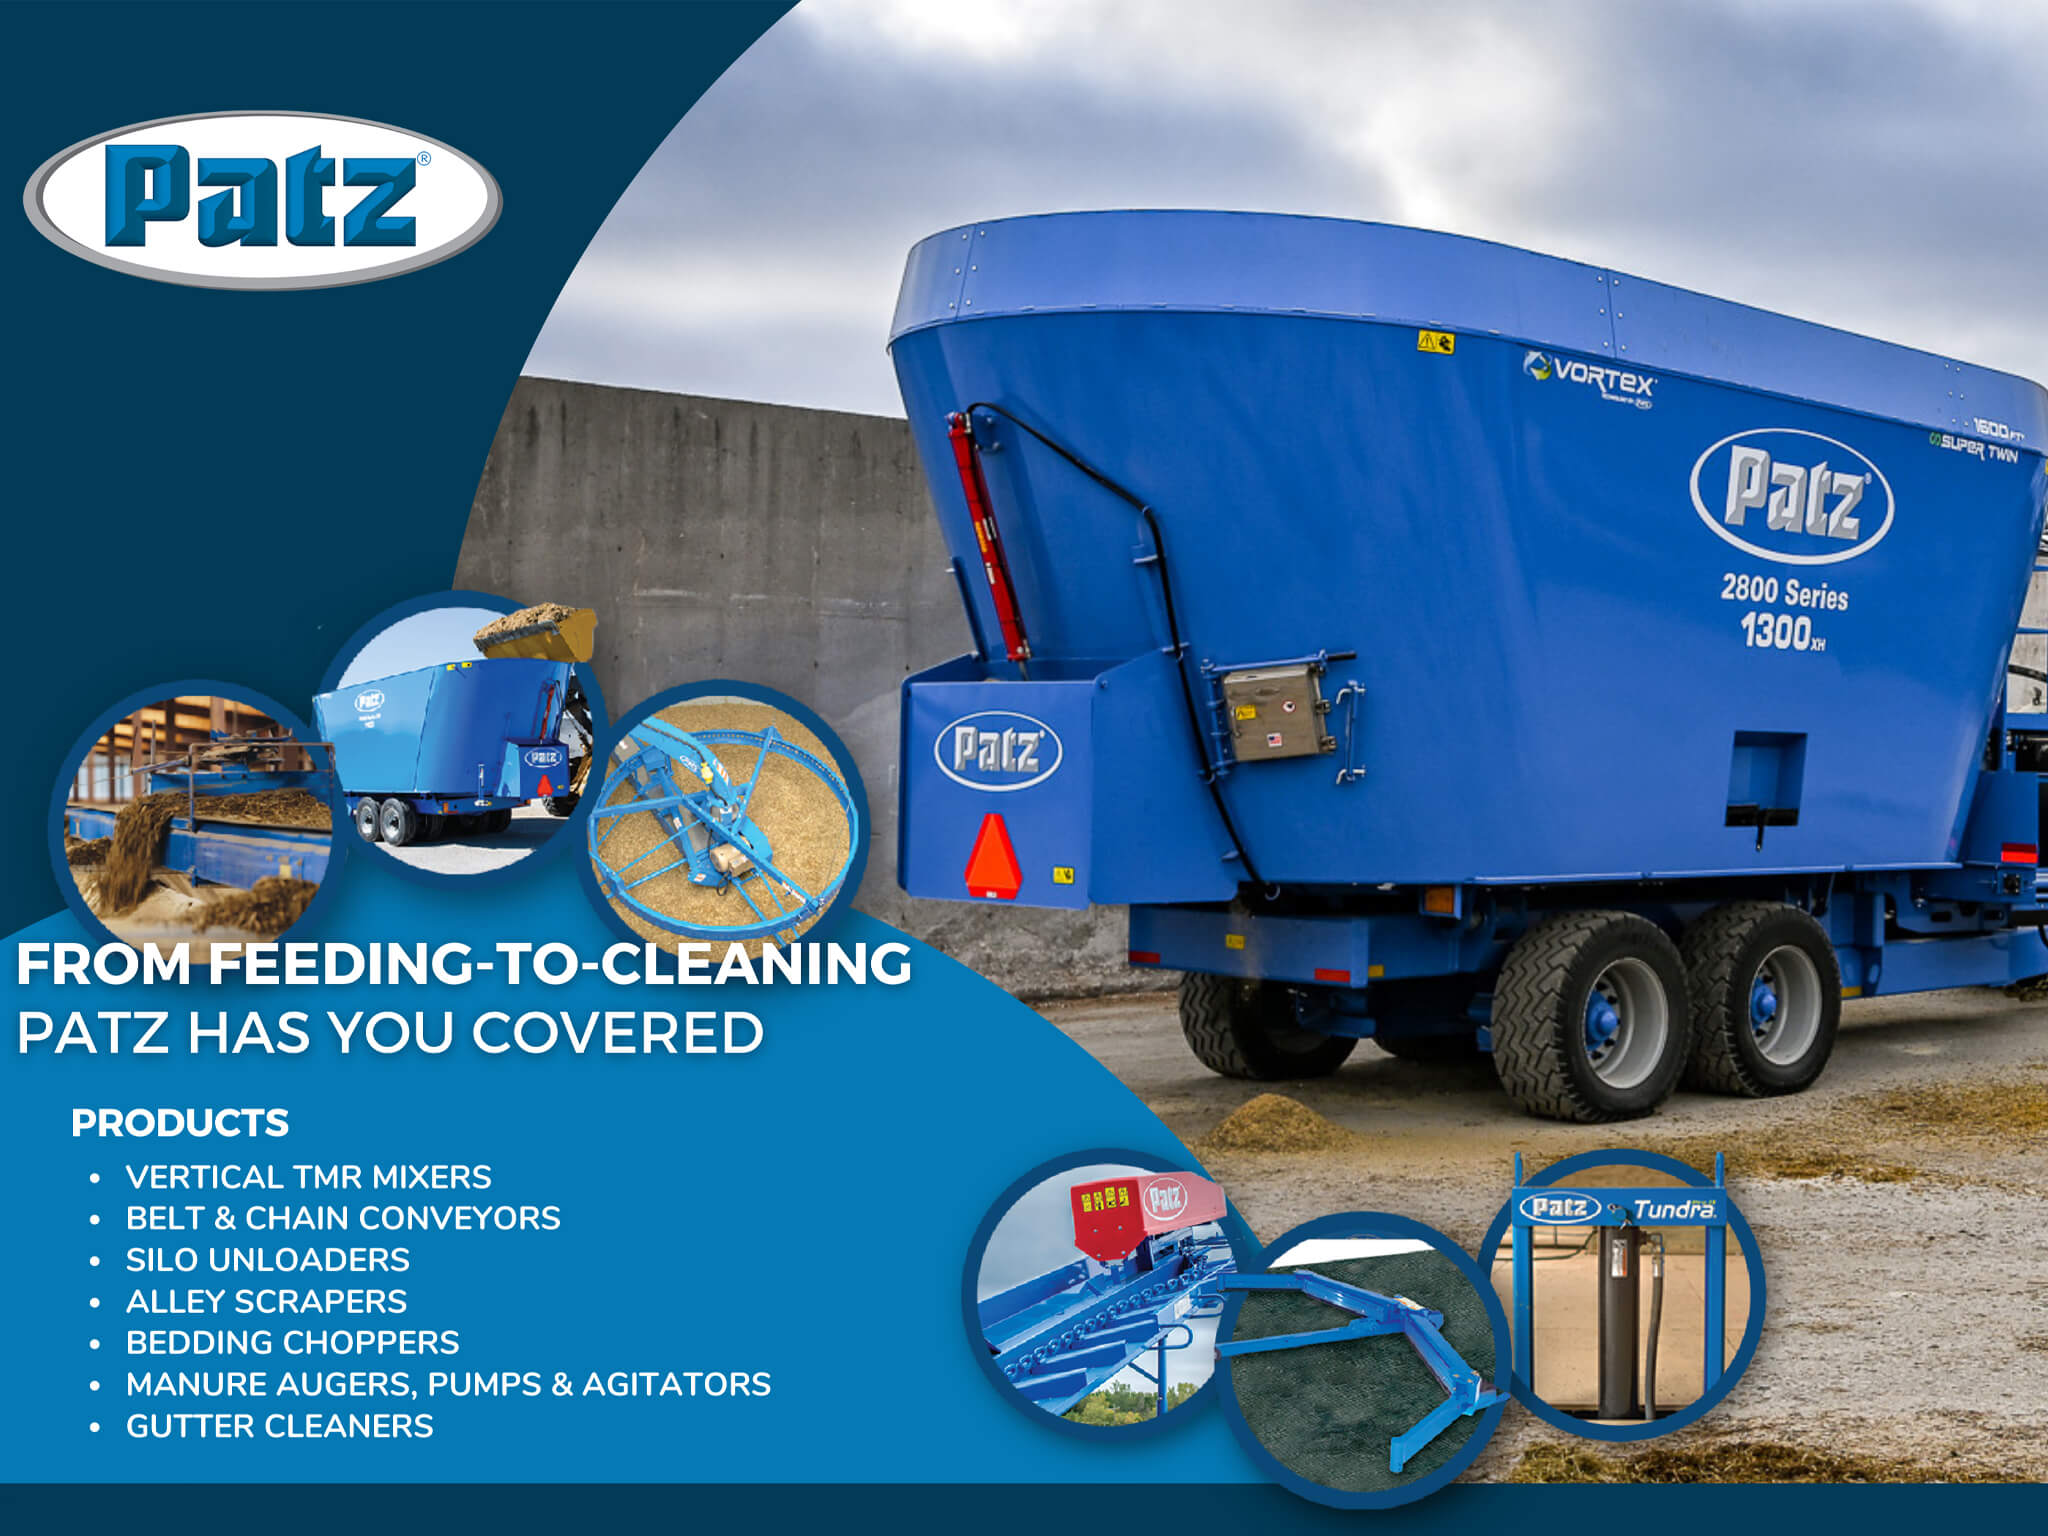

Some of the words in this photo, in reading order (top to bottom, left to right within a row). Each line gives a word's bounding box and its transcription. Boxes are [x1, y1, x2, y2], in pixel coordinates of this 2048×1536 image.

[1988, 444, 2019, 464] TWIN
[1724, 444, 1866, 541] Patz
[1720, 572, 1779, 604] 2800
[1784, 577, 1849, 611] Series
[1741, 611, 1812, 651] 1300
[954, 725, 1040, 773] Patz
[1150, 1185, 1182, 1213] Patz
[1532, 1198, 1588, 1217] Patz
[1634, 1199, 1715, 1219] Tundra
